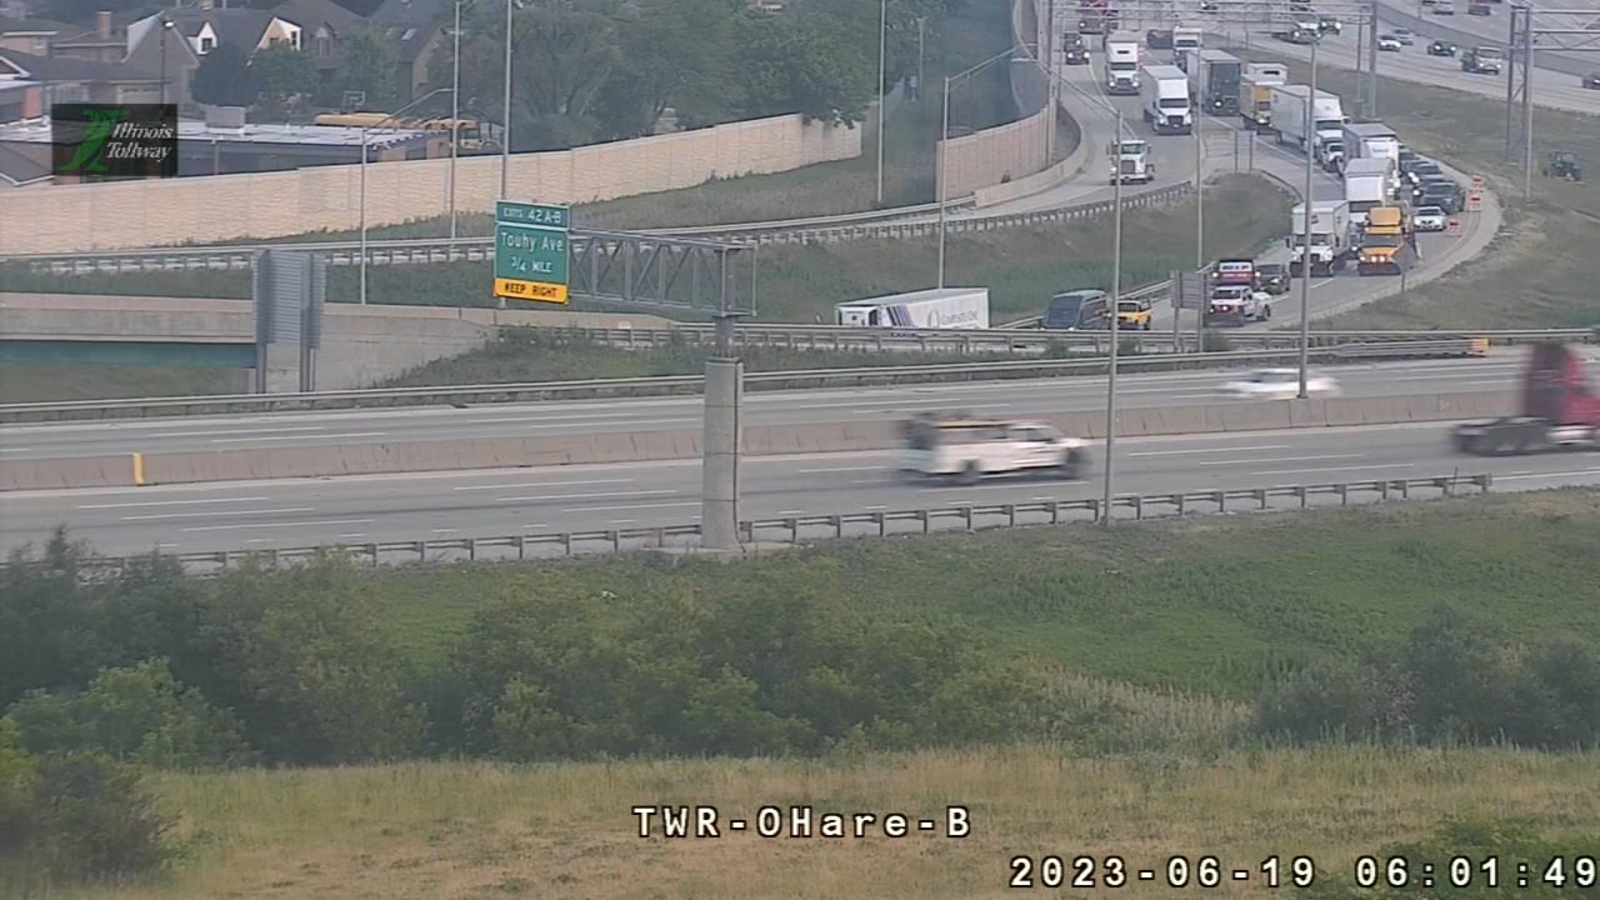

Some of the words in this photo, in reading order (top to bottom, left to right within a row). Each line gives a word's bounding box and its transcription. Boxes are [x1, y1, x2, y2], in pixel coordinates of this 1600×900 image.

[527, 209, 543, 222] 42
[501, 231, 536, 253] Touhy
[541, 236, 564, 252] Ave
[532, 260, 554, 273] MILE
[504, 282, 526, 294] KEEP
[532, 284, 558, 299] RIGHT
